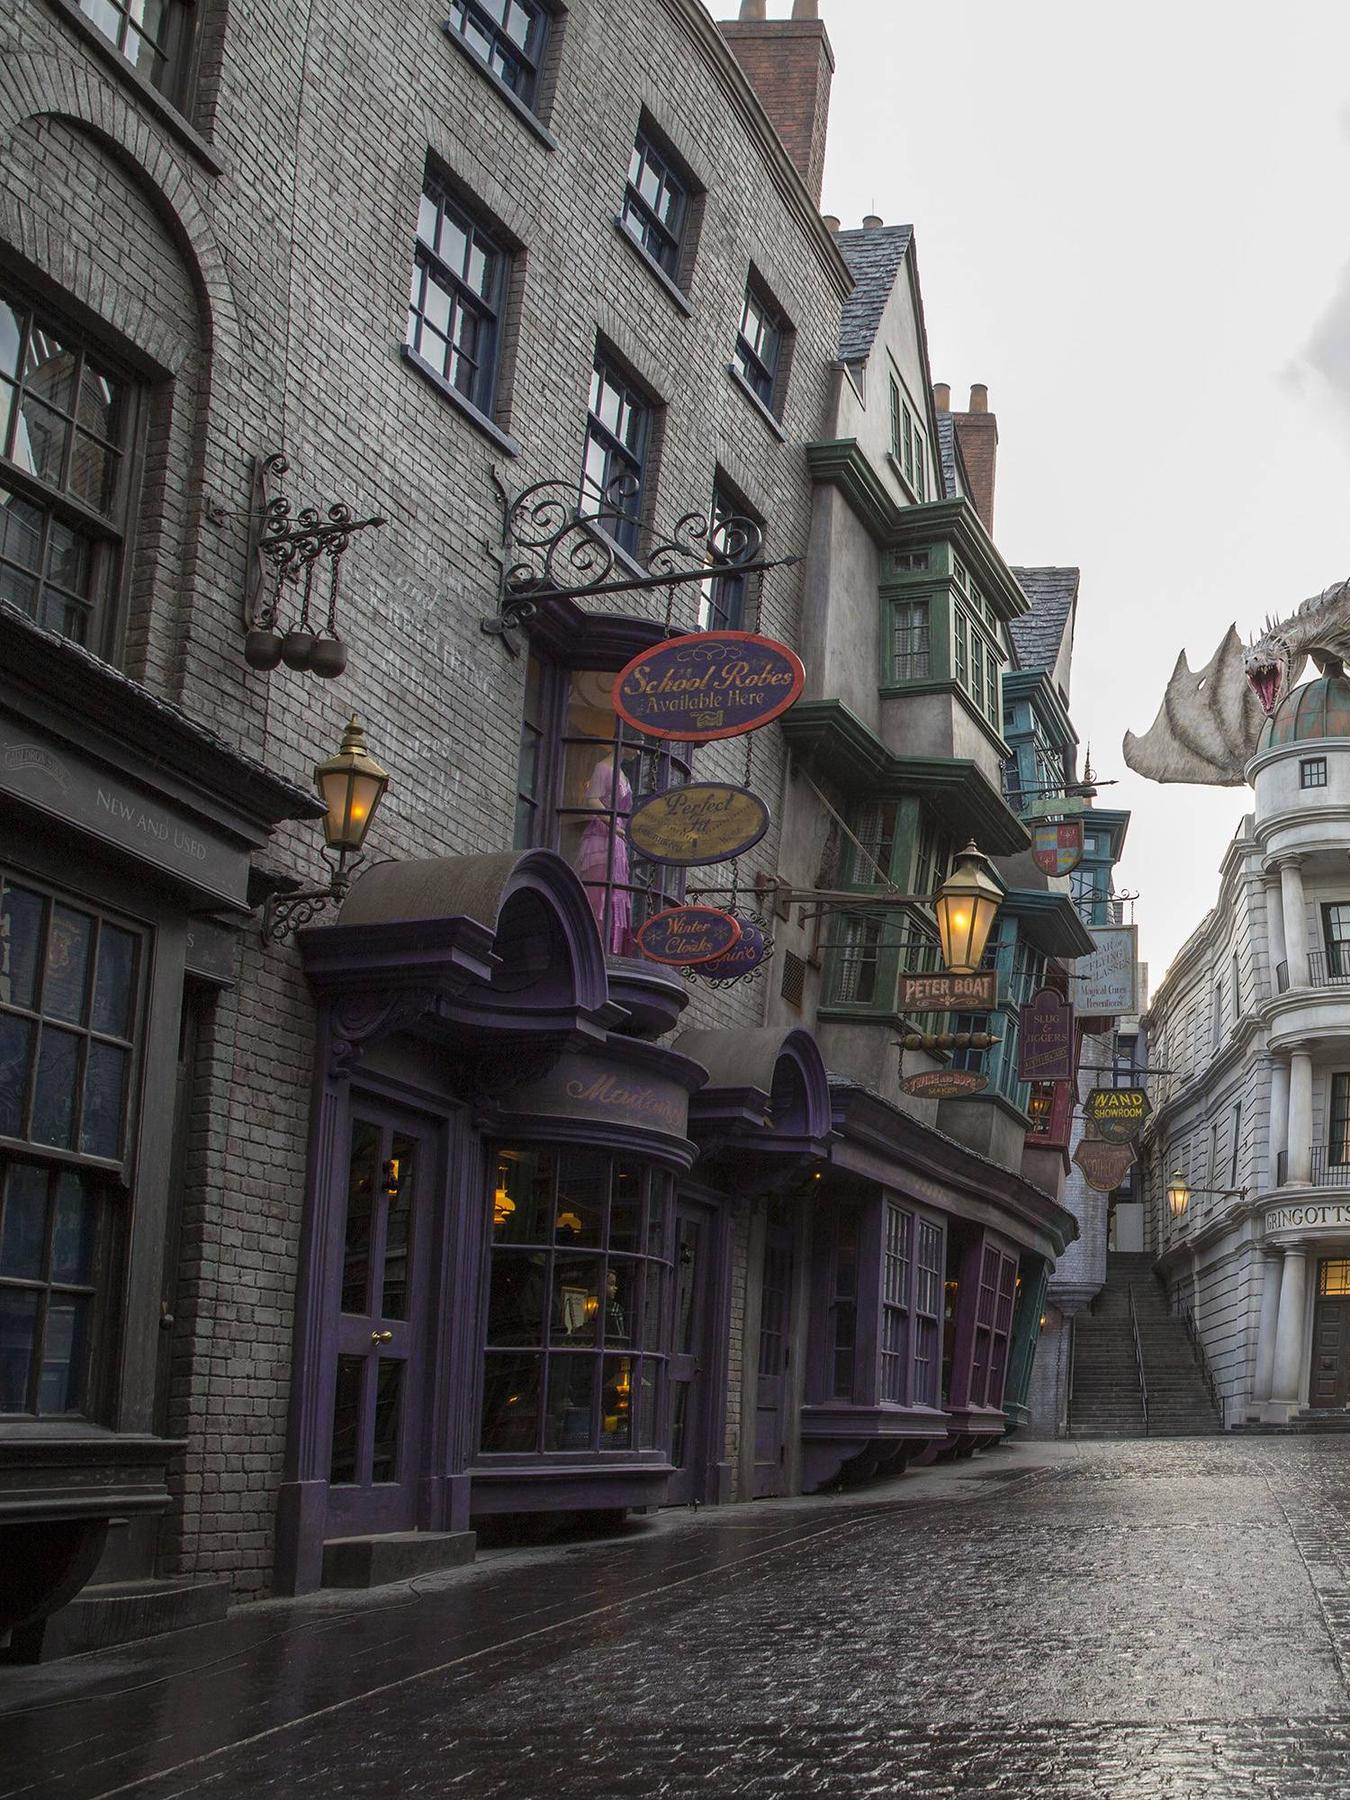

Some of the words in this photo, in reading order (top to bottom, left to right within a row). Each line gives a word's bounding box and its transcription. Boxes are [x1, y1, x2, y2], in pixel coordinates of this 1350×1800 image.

[624, 665, 714, 695] School
[712, 660, 792, 689] Robes
[645, 693, 722, 714] Available
[727, 692, 765, 707] Here
[664, 792, 736, 816] Perfect
[97, 788, 135, 822] NEW
[136, 814, 169, 841] AND
[173, 827, 207, 861] USED
[667, 917, 711, 934] Winter
[665, 937, 713, 954] Cloaks
[904, 978, 950, 1003] PETER
[954, 976, 992, 998] BOAT
[1033, 1014, 1060, 1023] SLUG
[1094, 1093, 1143, 1107] WAND
[1094, 1108, 1143, 1119] SHOWROOM
